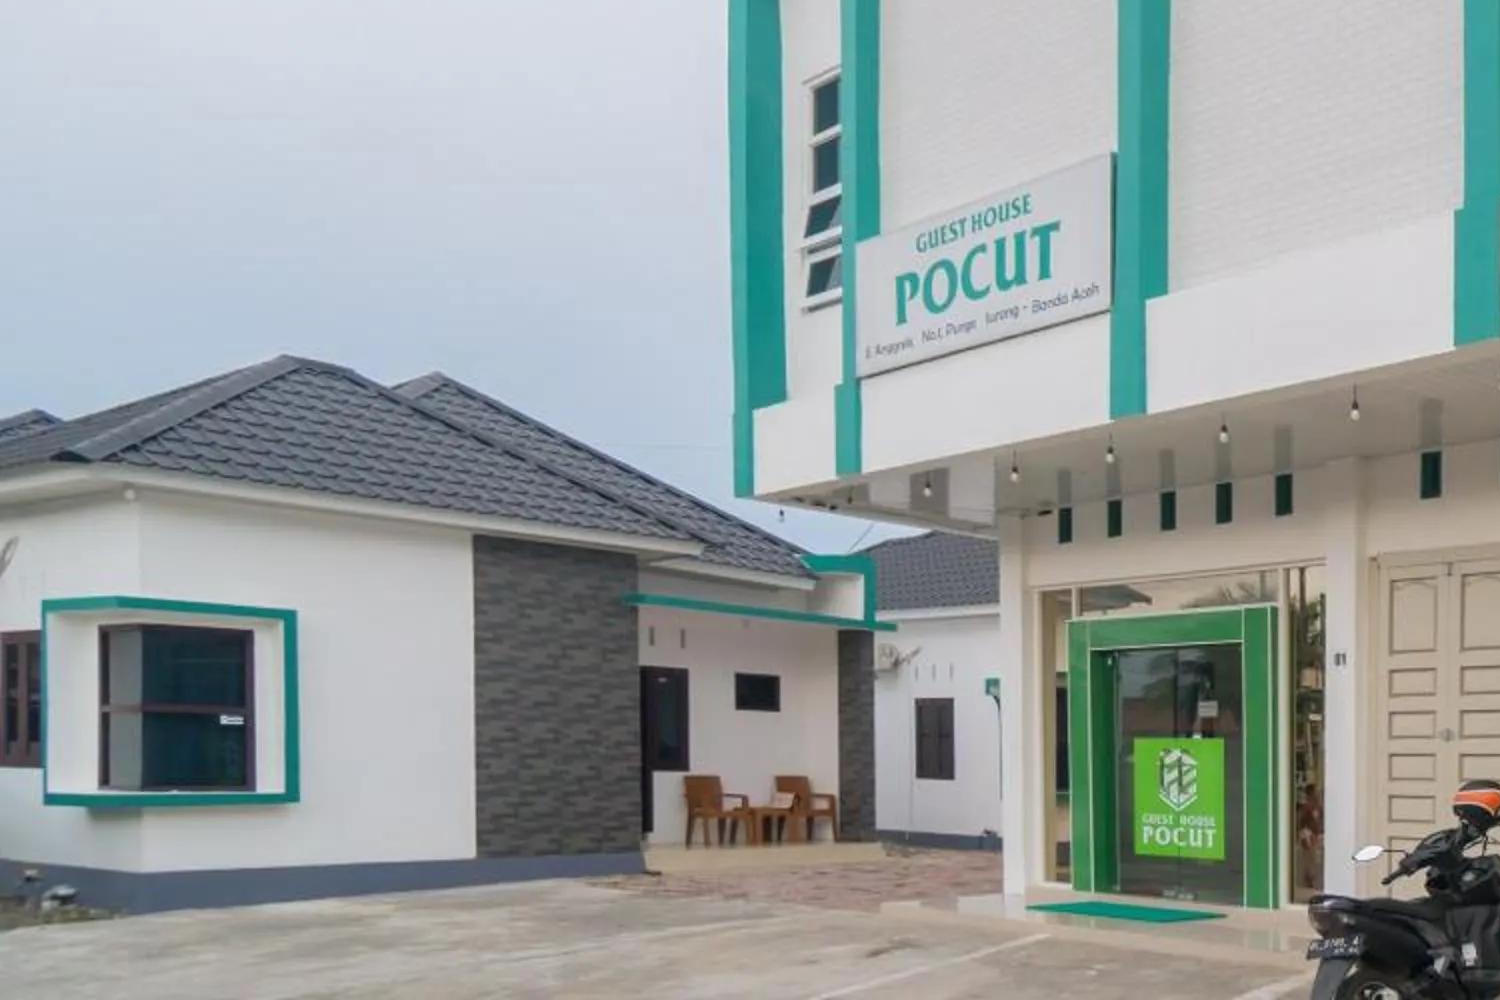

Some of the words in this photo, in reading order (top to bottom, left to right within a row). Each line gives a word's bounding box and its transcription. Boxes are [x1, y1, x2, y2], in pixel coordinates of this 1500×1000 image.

[915, 216, 967, 253] GUEST
[971, 194, 1033, 233] HOUSE
[894, 220, 1062, 326] POCUT
[1142, 825, 1217, 849] POCUT
